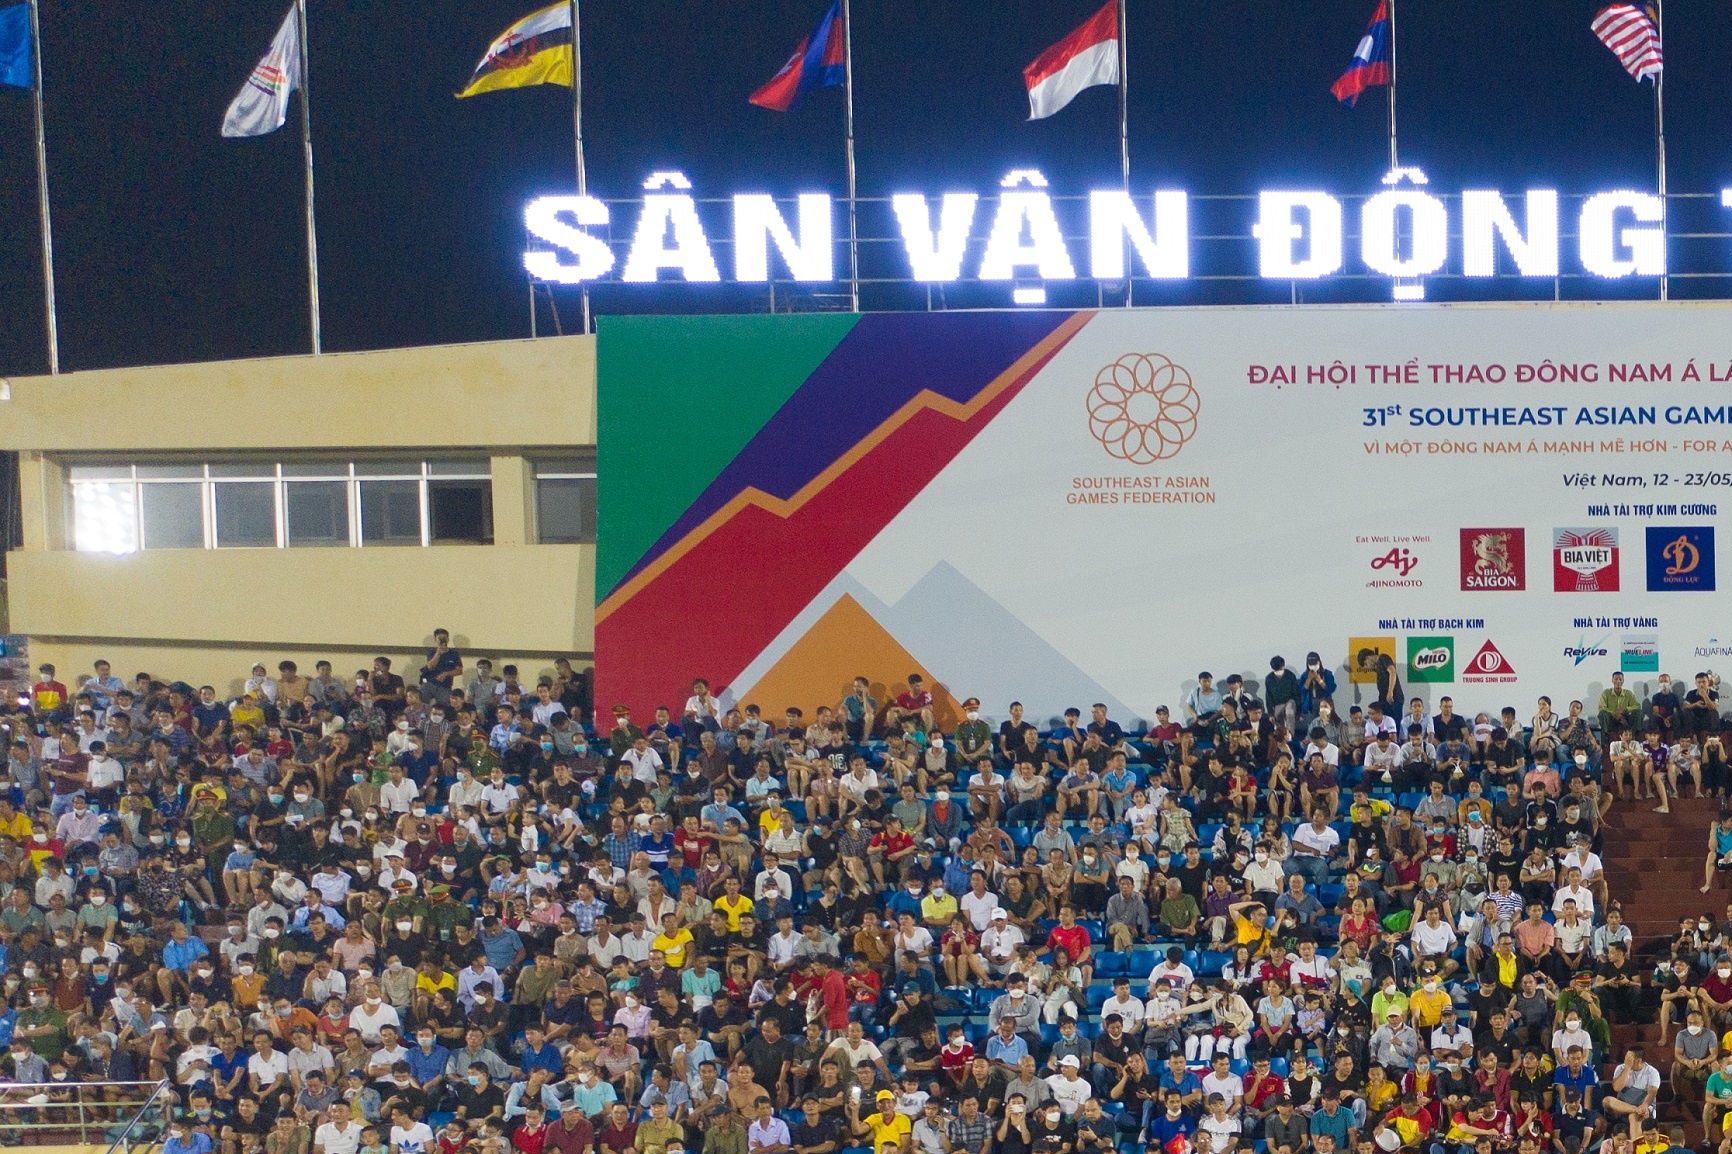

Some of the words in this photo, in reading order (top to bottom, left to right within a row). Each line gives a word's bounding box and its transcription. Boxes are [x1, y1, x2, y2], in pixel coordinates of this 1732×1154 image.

[523, 170, 834, 284] SÂN
[892, 168, 1189, 304] VẬN
[1253, 166, 1664, 300] ĐỘNG
[1247, 365, 1296, 389] ĐẠI
[1307, 360, 1356, 389] HỘI
[1364, 357, 1419, 384] THỂ
[1427, 364, 1507, 384] THAO
[1514, 359, 1599, 383] ĐÔNG
[1608, 363, 1672, 383] NAM
[1681, 358, 1701, 382] Á
[1409, 407, 1568, 427] SOUTHEAST
[1575, 406, 1656, 426] ASIAN
[1364, 442, 1379, 454] VÌ
[1385, 441, 1421, 454] MỘT
[1427, 440, 1477, 453] ĐÔNG
[1483, 442, 1521, 453] NAM
[1527, 441, 1538, 452] Á
[1544, 442, 1594, 452] MẠNH
[1600, 439, 1624, 452] MẼ
[1630, 439, 1667, 452] HƠN
[1683, 440, 1716, 451] FOR
[1722, 440, 1732, 451] A
[1073, 477, 1159, 488] SOUTHEAST
[1166, 477, 1209, 487] ASIAN
[1563, 473, 1596, 489] Việt
[1602, 474, 1647, 488] Nam,
[1653, 473, 1669, 486] 12
[1067, 493, 1118, 503] GAMES
[1124, 492, 1215, 503] FEDERATION
[1588, 503, 1610, 516] NHÀ
[1613, 503, 1630, 516] TÀI
[1633, 504, 1654, 518] TRỢ
[1656, 504, 1677, 516] KIM
[1680, 503, 1717, 516] CƯƠNG
[1564, 551, 1583, 563] BIA
[1587, 549, 1609, 564] VIỆT
[1366, 580, 1422, 588] AJINOMOTO
[1467, 576, 1517, 587] SAIGON
[1378, 618, 1398, 629] NHÀ
[1401, 618, 1416, 629] TÀI
[1418, 618, 1436, 631] TRỢ
[1437, 618, 1464, 630] BẠCH
[1465, 618, 1485, 629] KIM
[1573, 616, 1593, 628] NHÀ
[1596, 616, 1611, 628] TÀI
[1613, 617, 1631, 629] TRỢ
[1632, 616, 1658, 628] VÀNG
[1418, 652, 1447, 665] MILO
